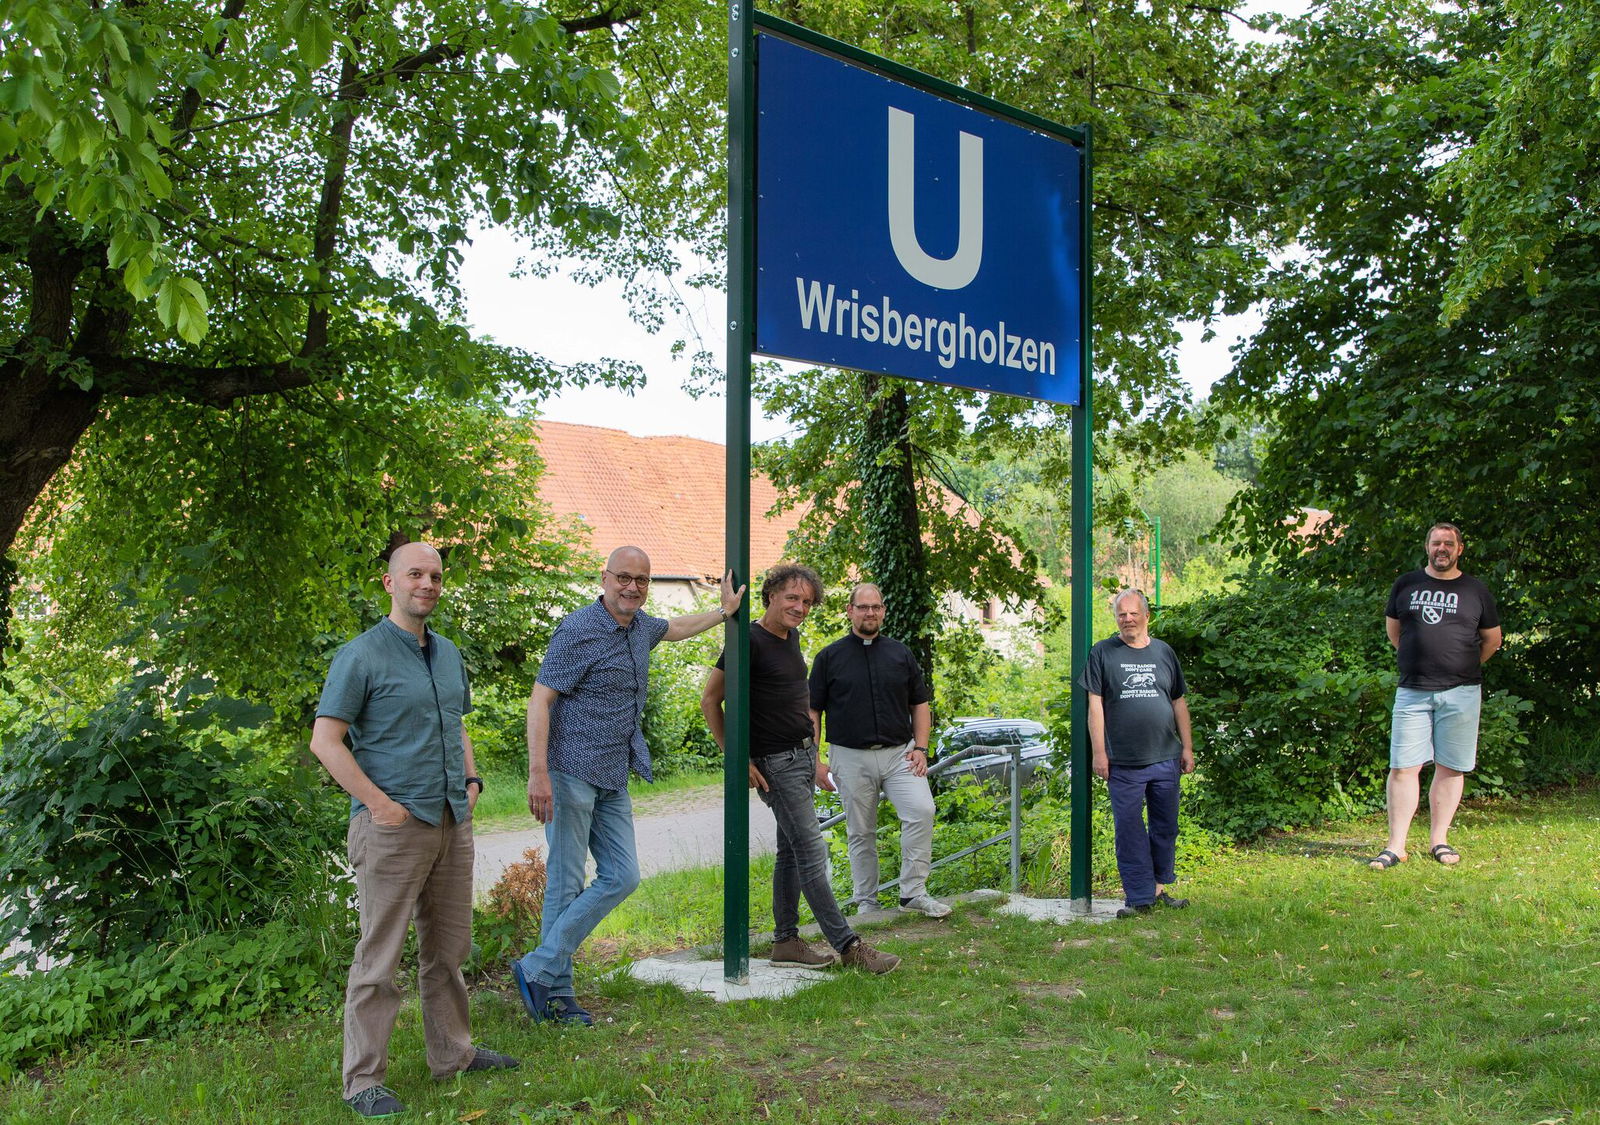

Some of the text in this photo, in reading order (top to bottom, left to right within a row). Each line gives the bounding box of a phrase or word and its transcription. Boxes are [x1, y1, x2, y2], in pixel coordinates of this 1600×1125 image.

[888, 105, 984, 291] U
[796, 277, 1056, 376] Wrisbergholzen
[1411, 590, 1458, 605] 1000
